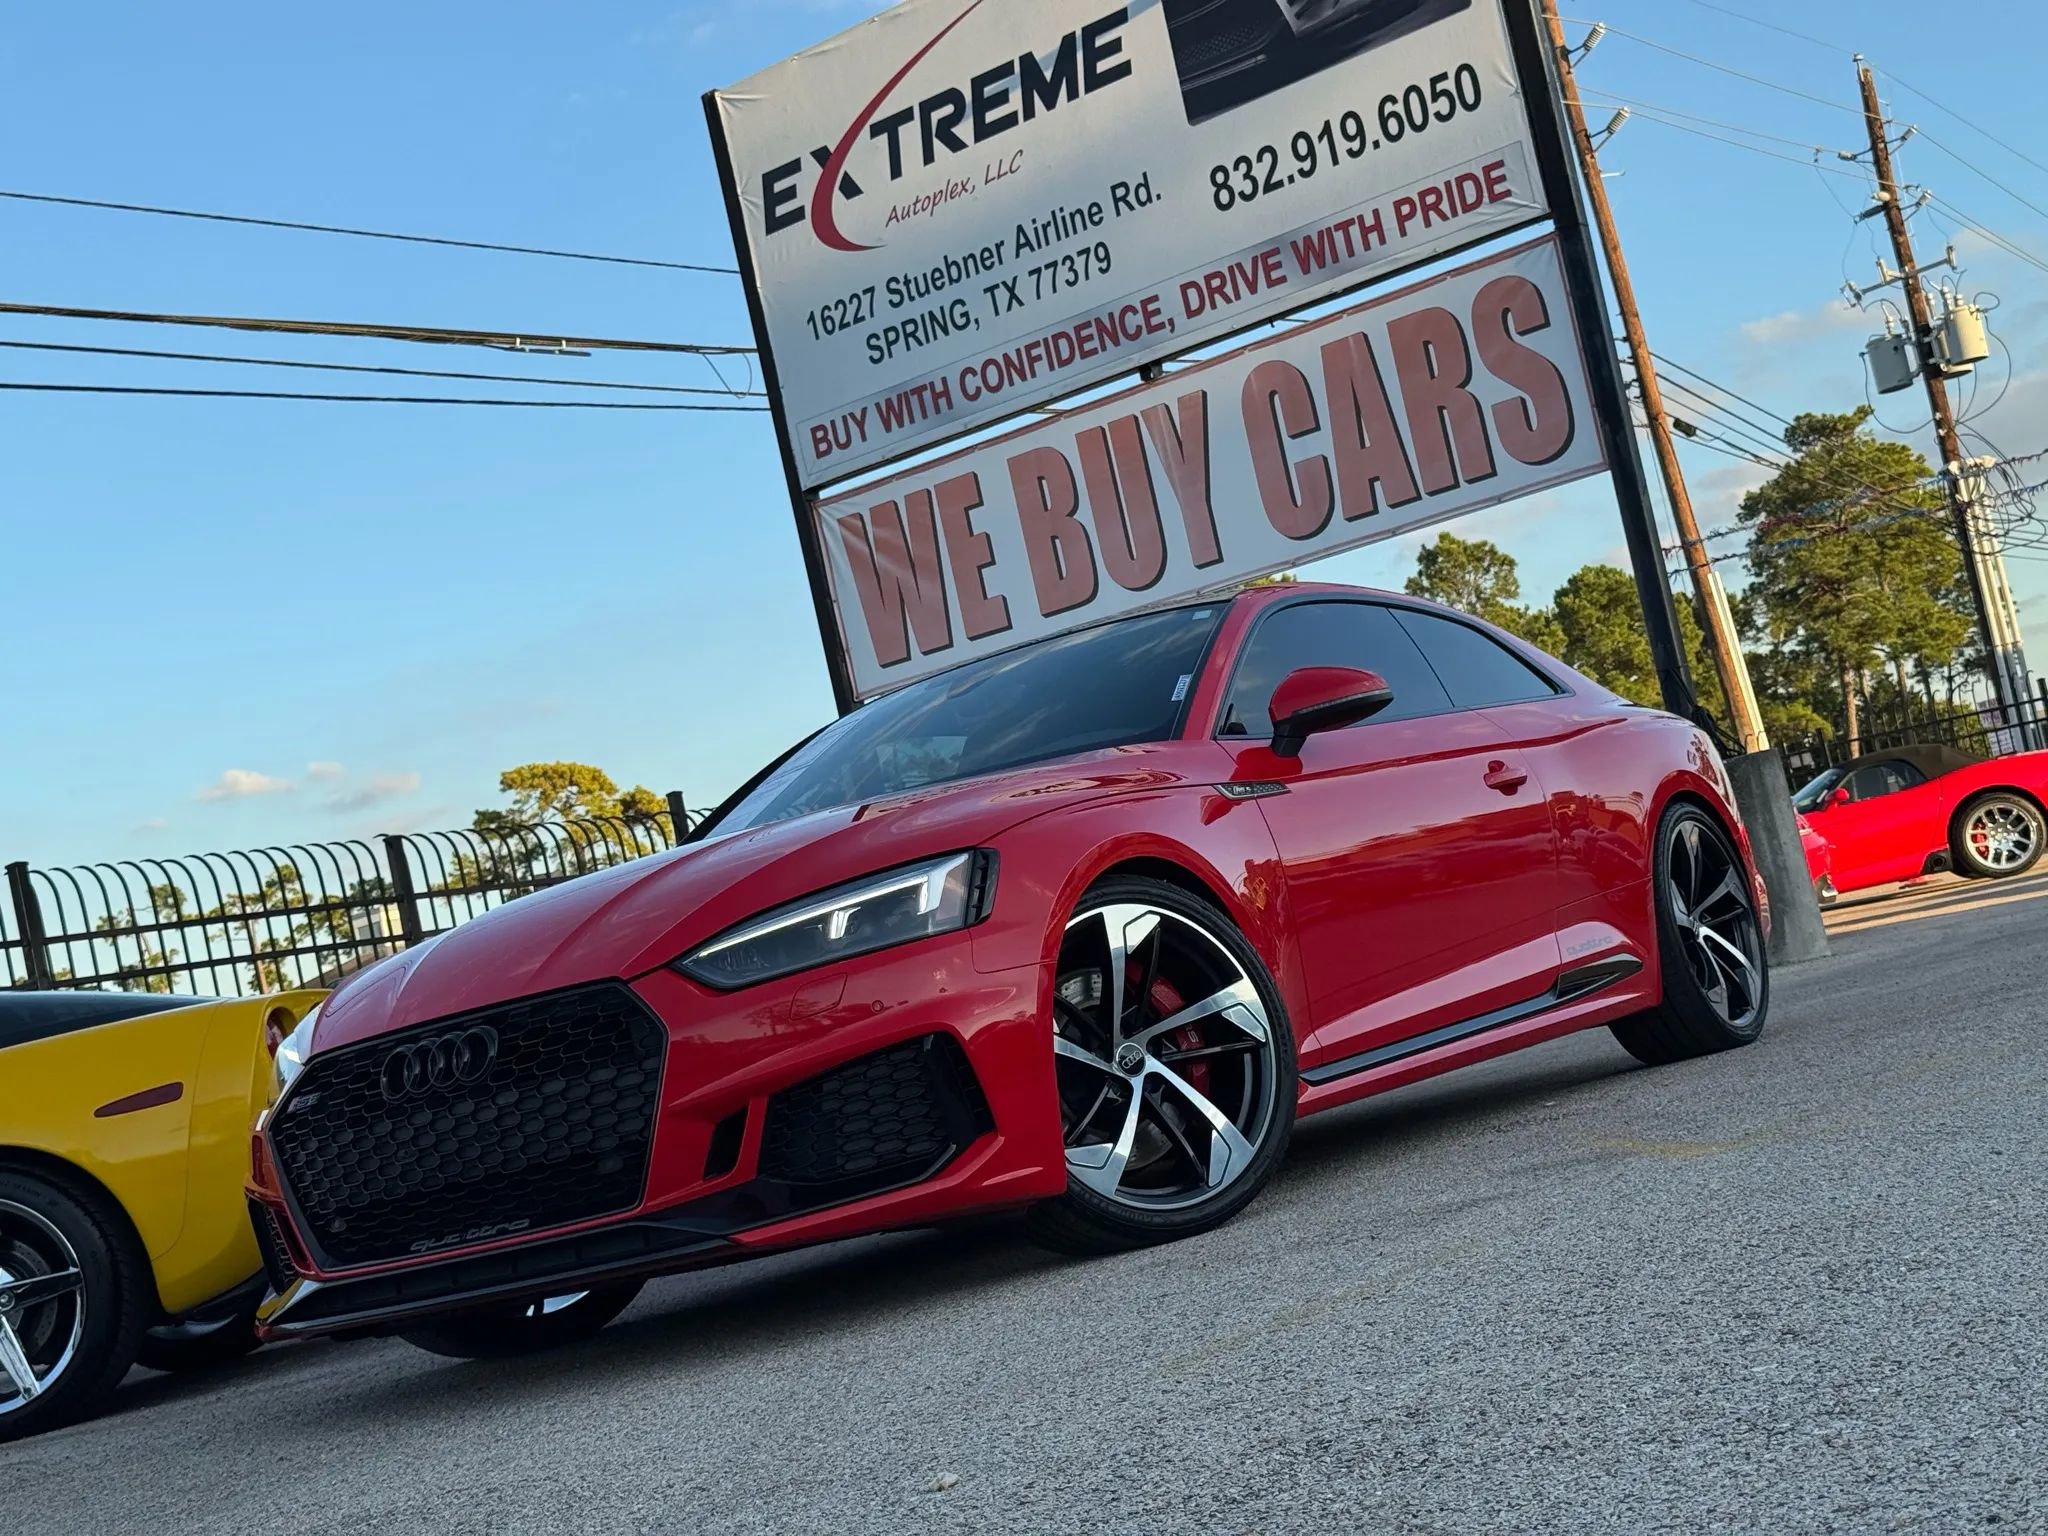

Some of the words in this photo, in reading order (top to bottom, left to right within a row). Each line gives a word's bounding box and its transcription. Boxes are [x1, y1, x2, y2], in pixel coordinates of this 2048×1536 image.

[761, 7, 1132, 242] EXTREME
[885, 174, 976, 228] Autoplex,
[983, 149, 1024, 187] LLC
[1209, 62, 1482, 212] 832.919.6050
[806, 286, 877, 341] 16227
[887, 240, 1005, 309] Stuebner
[1014, 202, 1104, 260] Airline
[1110, 171, 1163, 218] Rd.
[810, 405, 869, 460] BUY
[874, 376, 953, 434] WITH
[959, 293, 1176, 401] CONFIDENCE,
[1179, 247, 1288, 319] DRIVE
[1290, 213, 1387, 276] WITH
[1392, 159, 1512, 238] PRIDE
[865, 299, 981, 366] SPRING,
[982, 272, 1025, 318] TX
[1027, 241, 1112, 300] 77379
[837, 470, 1013, 668] WE
[1007, 389, 1225, 617] BUY
[1242, 275, 1575, 541] CARS
